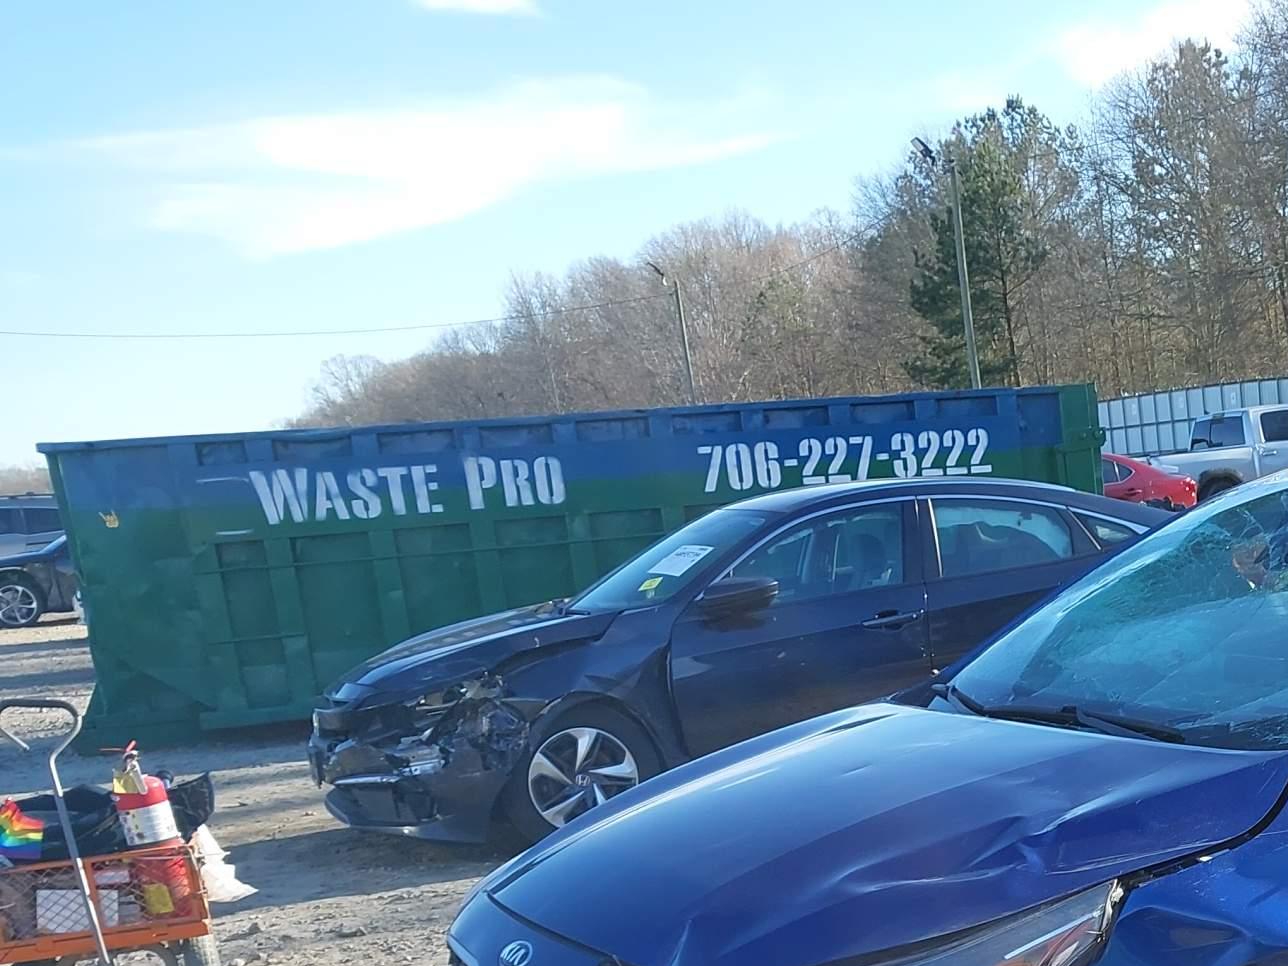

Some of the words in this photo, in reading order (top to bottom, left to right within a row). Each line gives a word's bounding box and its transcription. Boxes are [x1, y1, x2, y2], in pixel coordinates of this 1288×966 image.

[249, 464, 444, 525] WASTE
[463, 456, 567, 510] PRO
[697, 428, 993, 493] 706-227-3222
